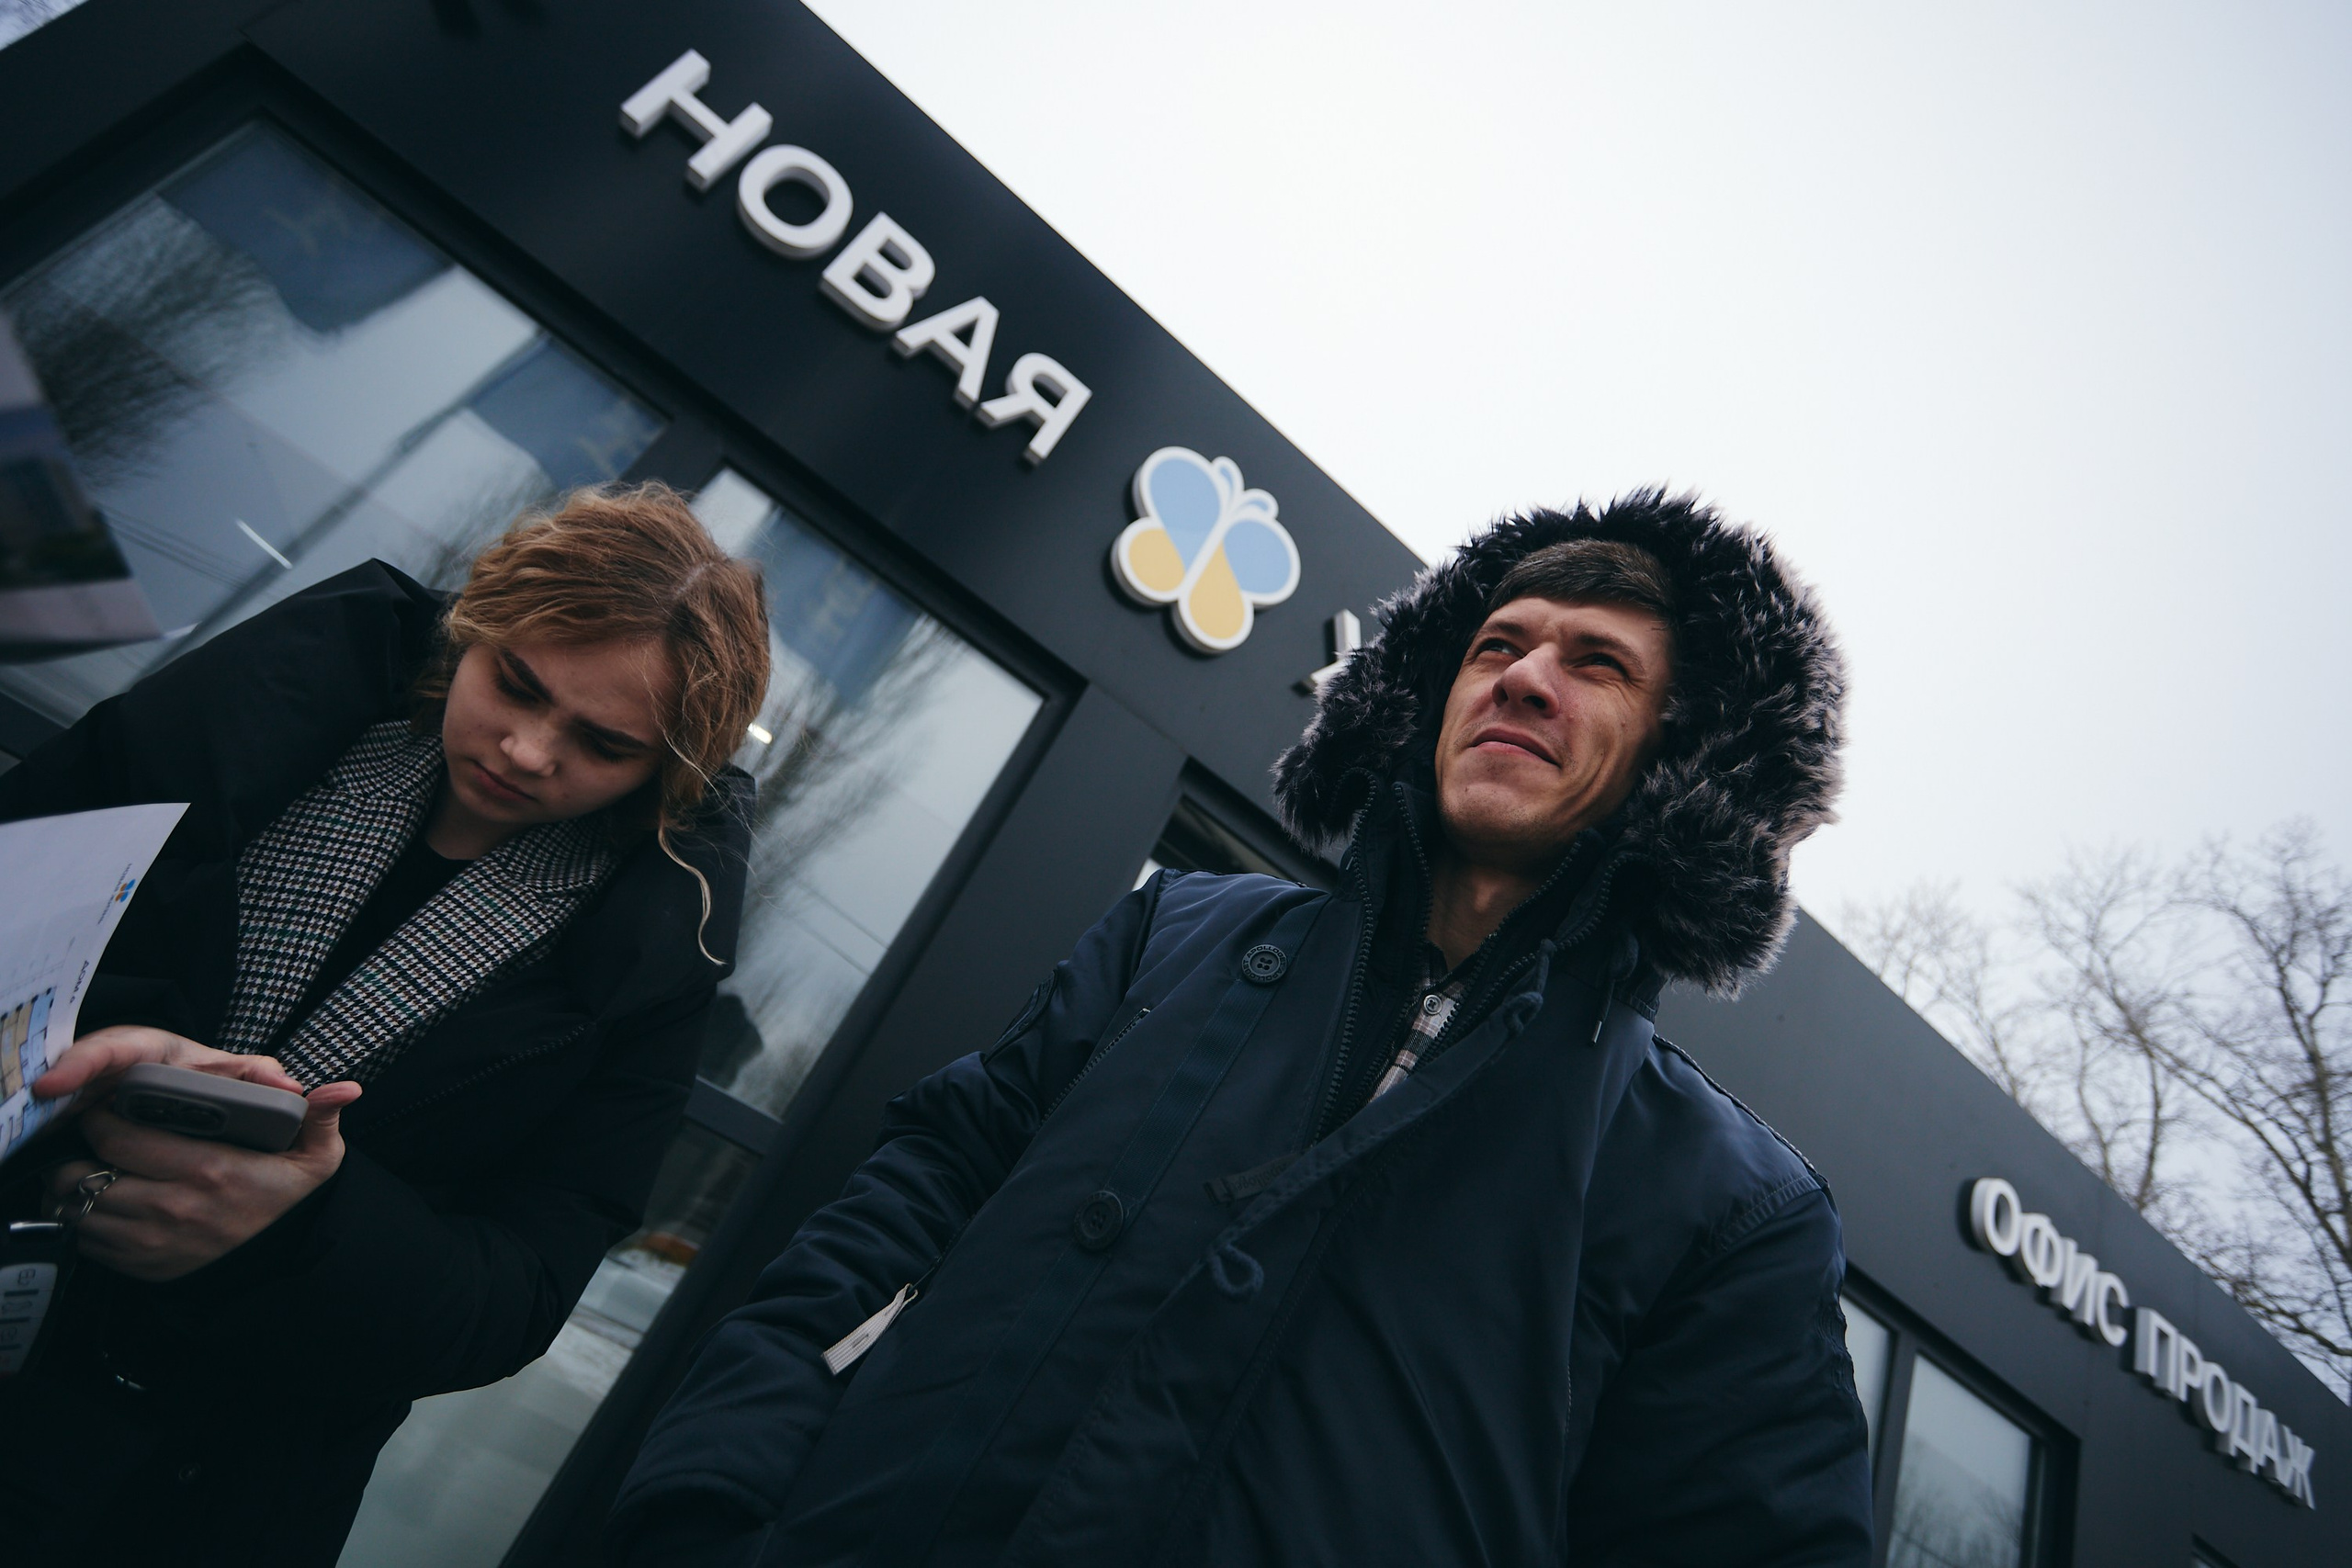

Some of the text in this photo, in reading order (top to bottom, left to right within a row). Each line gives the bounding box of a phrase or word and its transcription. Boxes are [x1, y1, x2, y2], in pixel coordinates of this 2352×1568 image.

[621, 49, 1091, 465] НОВАЯ
[1971, 1177, 2315, 1510] ОФИС ПРОДАЖ
